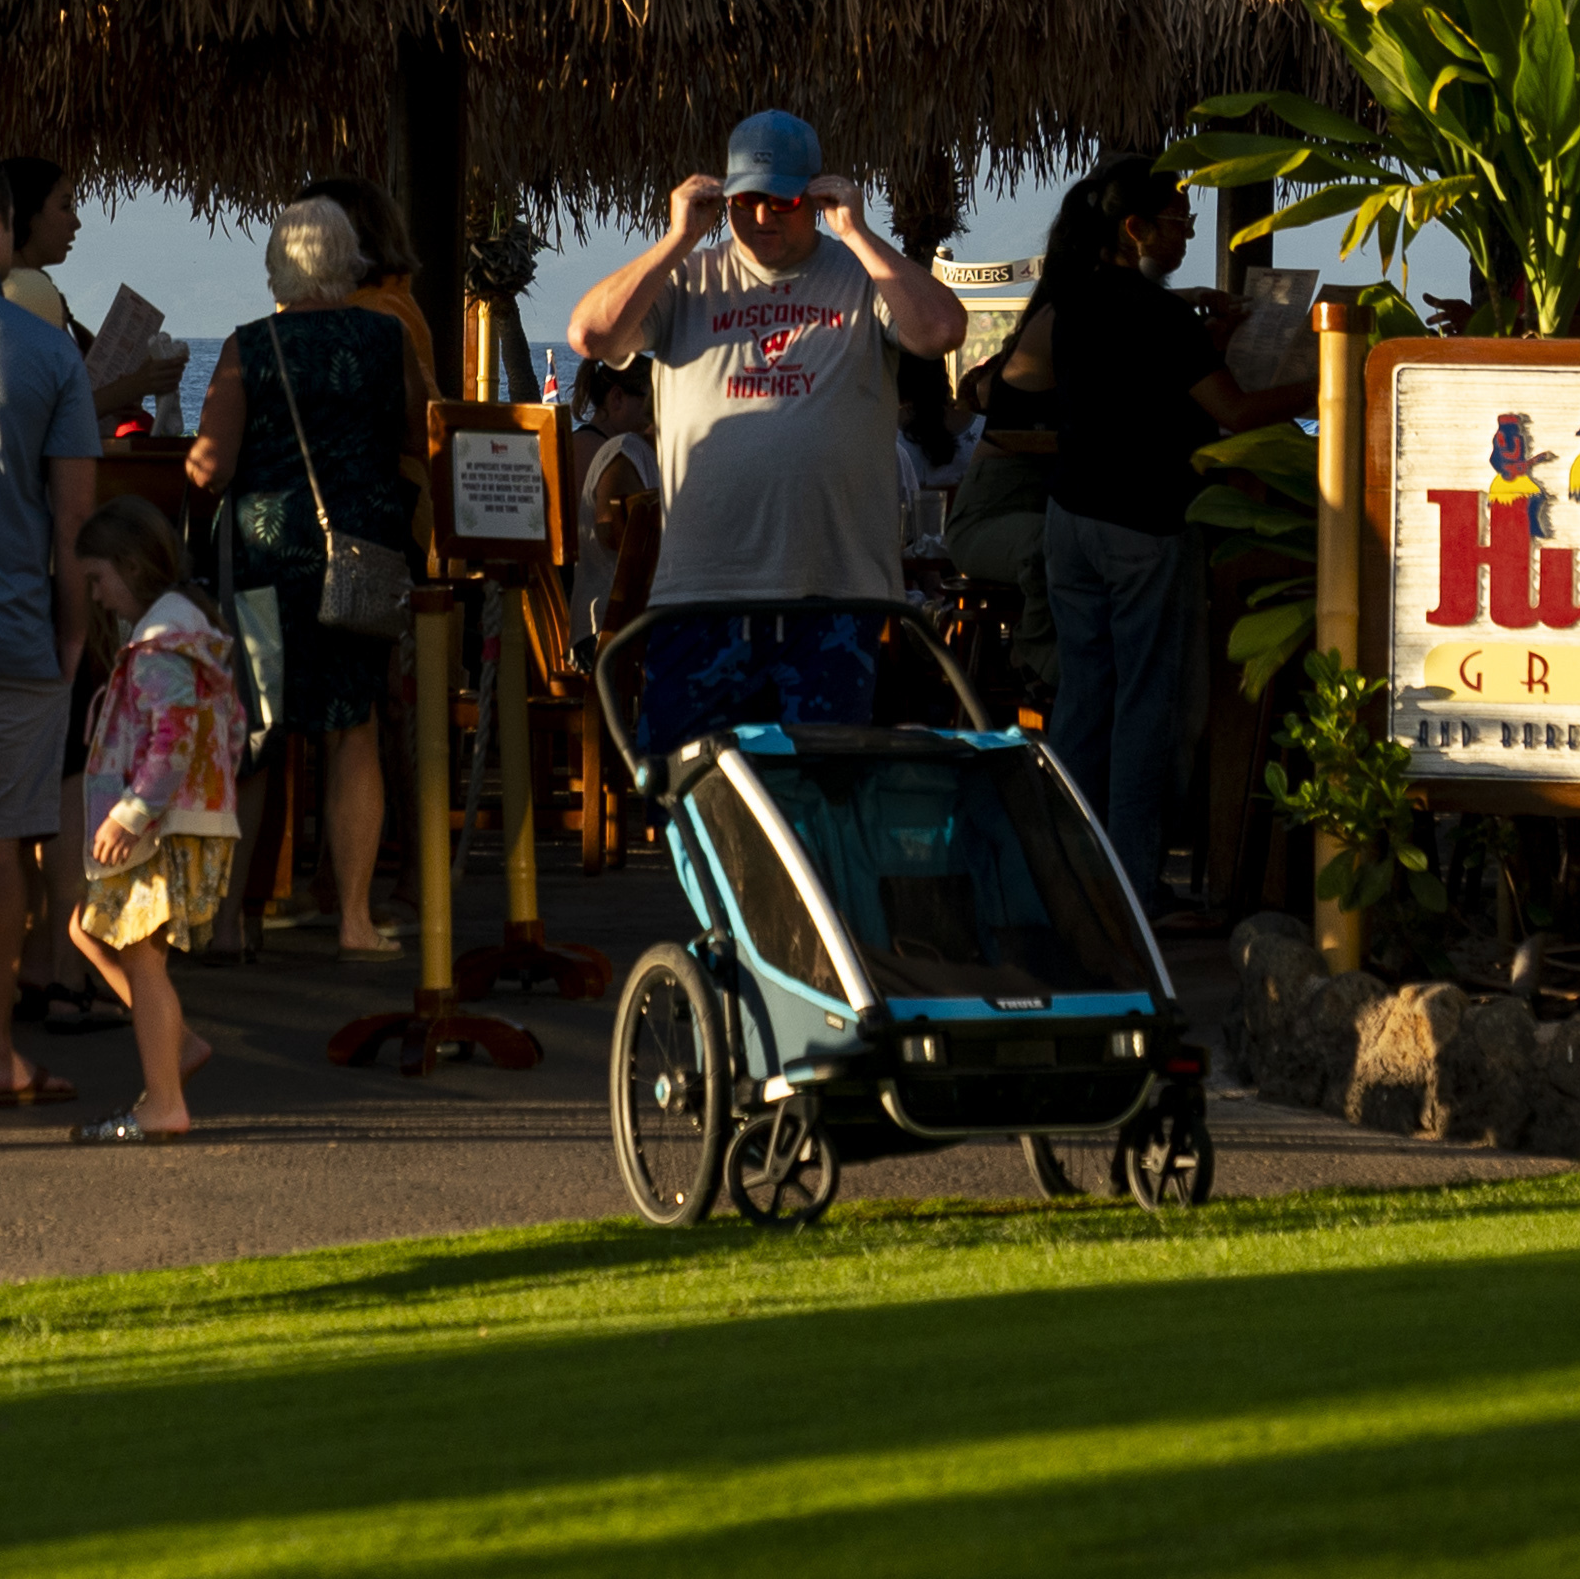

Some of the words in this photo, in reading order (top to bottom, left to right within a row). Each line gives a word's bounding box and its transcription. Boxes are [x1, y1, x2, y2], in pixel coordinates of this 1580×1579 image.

[941, 266, 1010, 282] WHALERS
[712, 303, 843, 334] WISCONSIN
[726, 372, 816, 398] HOCKEY
[1417, 719, 1473, 749] AND
[996, 997, 1044, 1010] THULE
